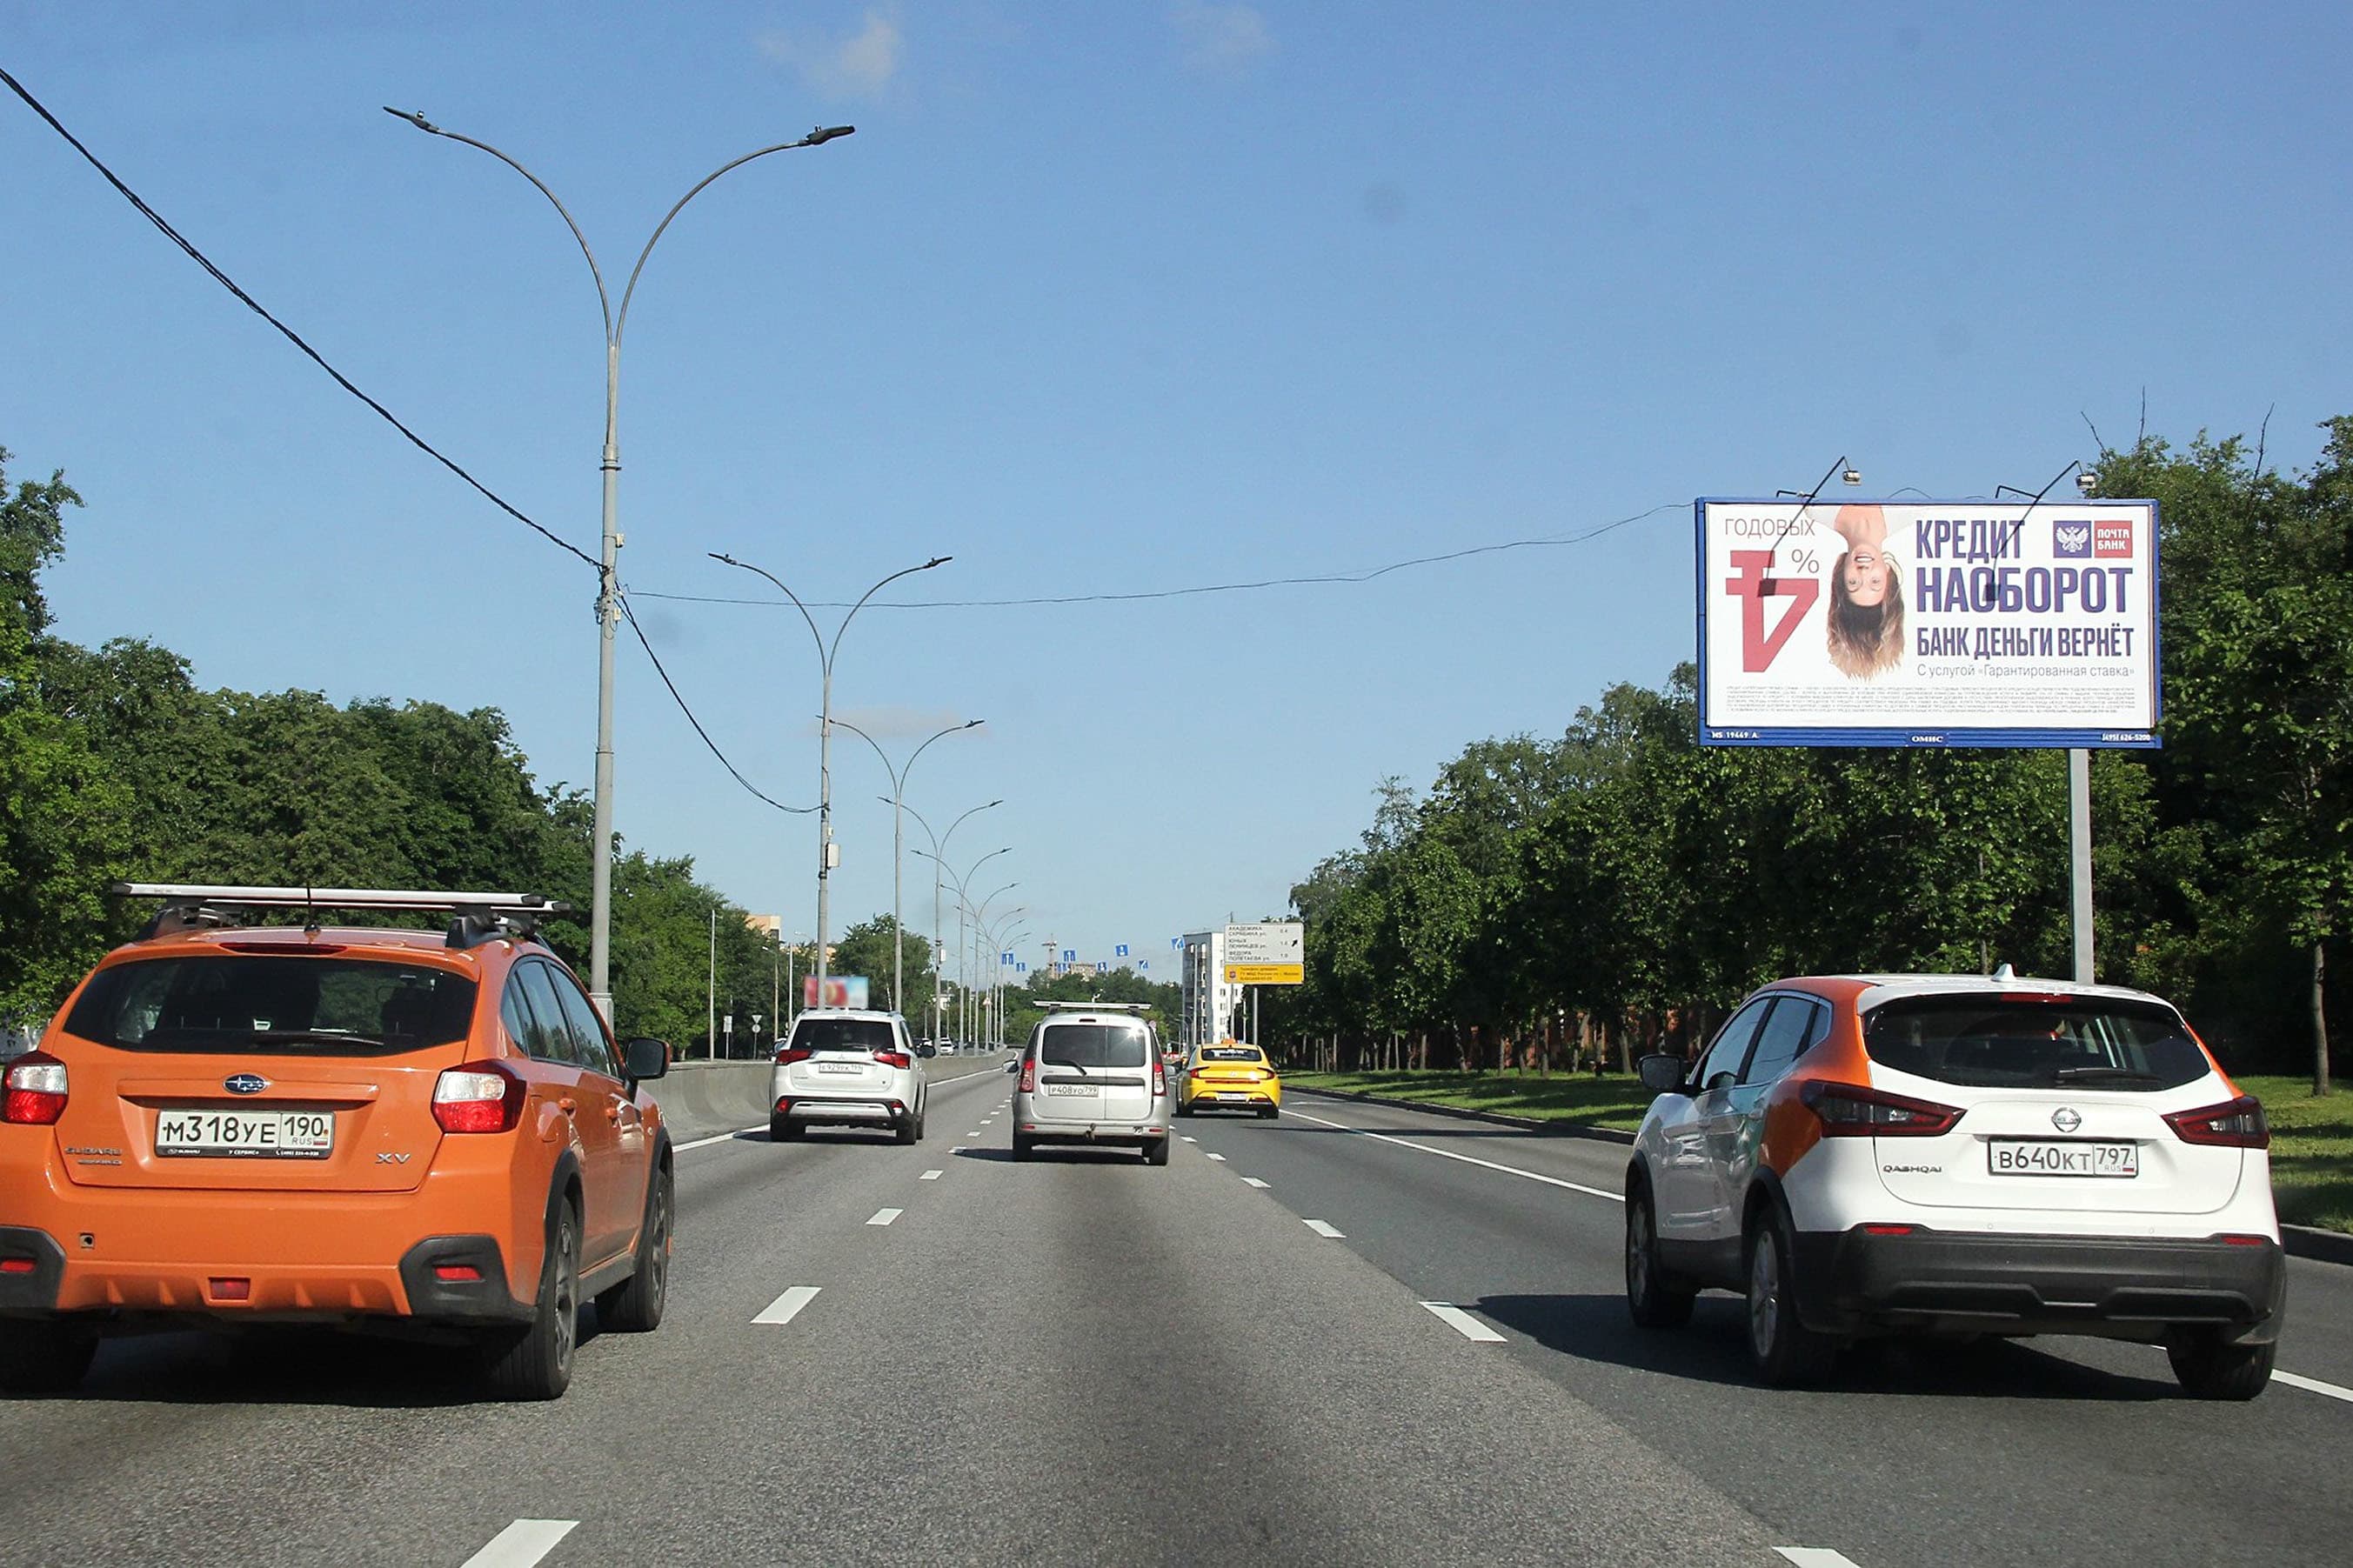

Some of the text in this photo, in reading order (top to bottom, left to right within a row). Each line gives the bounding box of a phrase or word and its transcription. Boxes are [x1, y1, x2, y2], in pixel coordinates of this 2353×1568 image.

[1725, 518, 1815, 539] ГОДОВЫХ
[2097, 528, 2130, 538] ПОЧТА
[1915, 520, 2025, 564] КРЕДИТ
[2097, 540, 2126, 550] БАНК
[1916, 567, 2134, 613] НАОБОРОТ
[1916, 623, 2135, 660] БАНК ДЕНЬГИ ВЕРНЁТ
[1917, 664, 2135, 679] С услугой «Гарантированная ставка»
[284, 1116, 324, 1137] 190
[291, 1137, 312, 1145] RUS
[375, 1152, 411, 1164] XV
[2096, 1148, 2131, 1165] 797
[1883, 1164, 1942, 1173] QASHQAI
